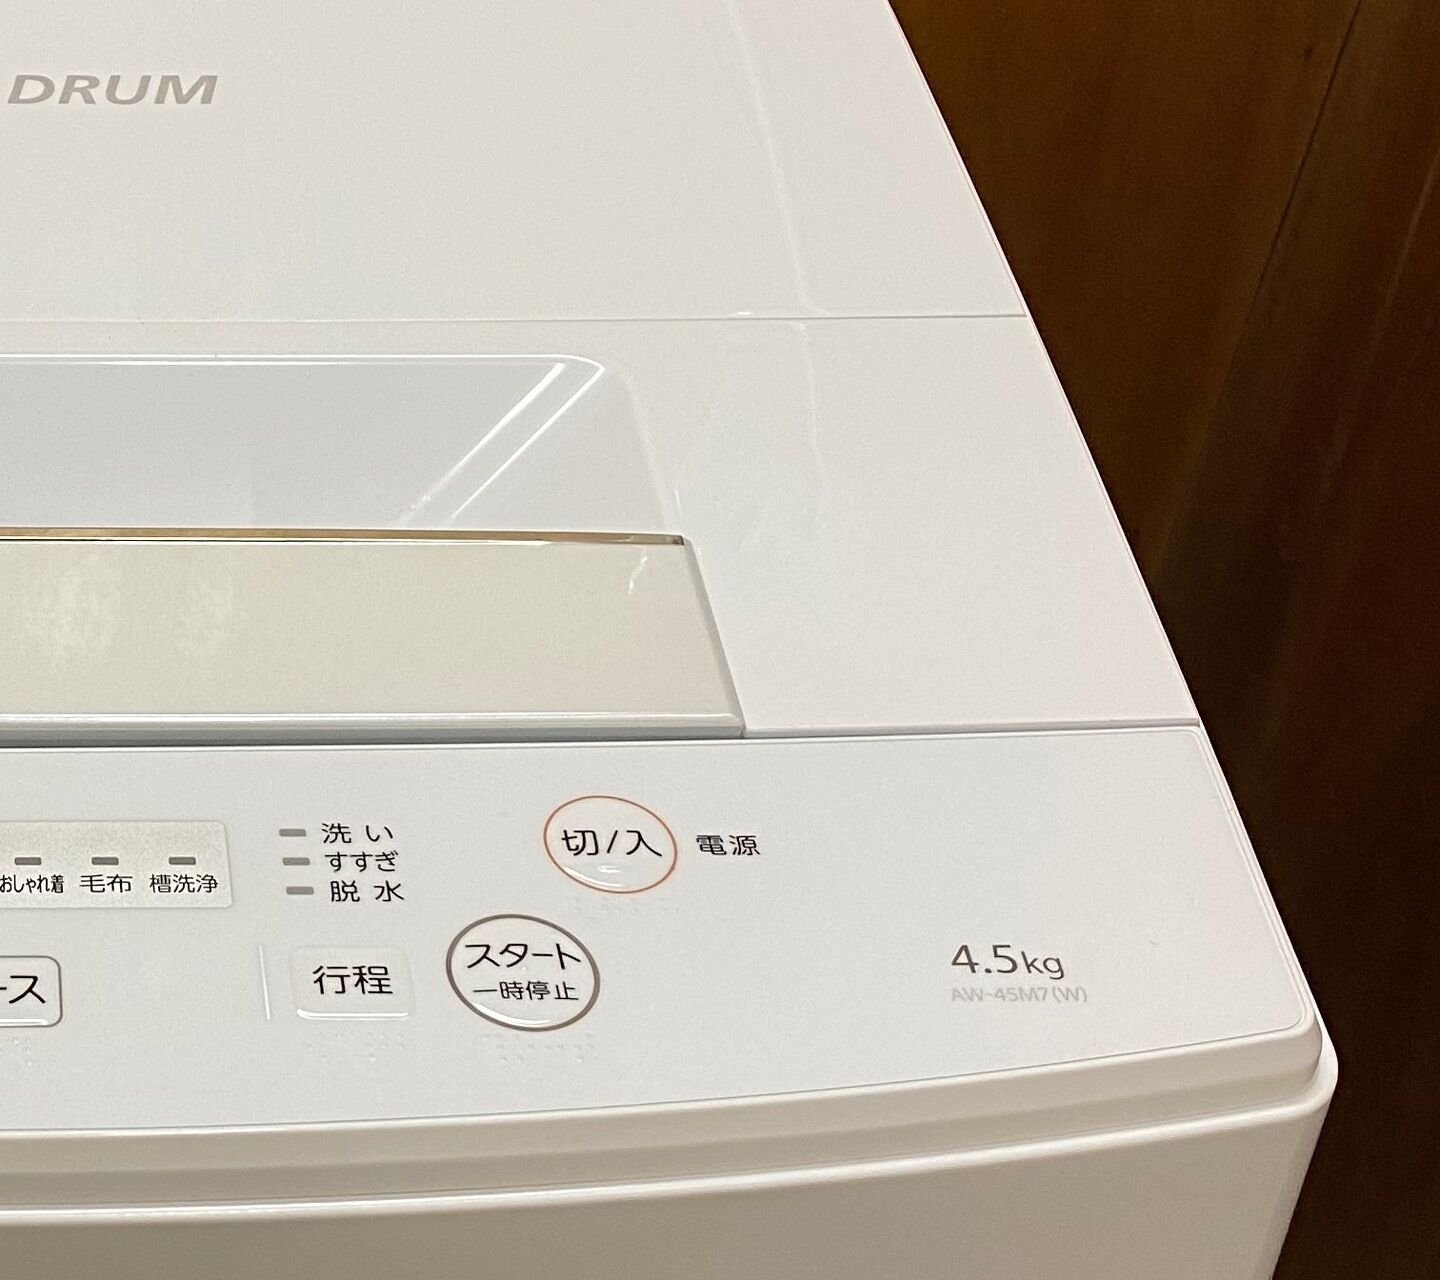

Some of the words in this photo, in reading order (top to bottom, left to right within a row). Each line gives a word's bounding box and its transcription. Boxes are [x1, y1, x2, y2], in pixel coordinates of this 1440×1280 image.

[7, 73, 219, 105] DRUM
[695, 834, 761, 856] 電源
[325, 851, 399, 873] すすぎ
[0, 875, 64, 894] おしゃれ着
[80, 874, 132, 893] 毛布
[149, 874, 219, 894] 槽洗浄
[466, 943, 581, 971] スタート
[951, 945, 1064, 980] 4.5kg
[312, 965, 393, 995] 行程
[473, 981, 579, 1001] 一時停止
[951, 986, 1088, 1003] AW-45M7(W)
